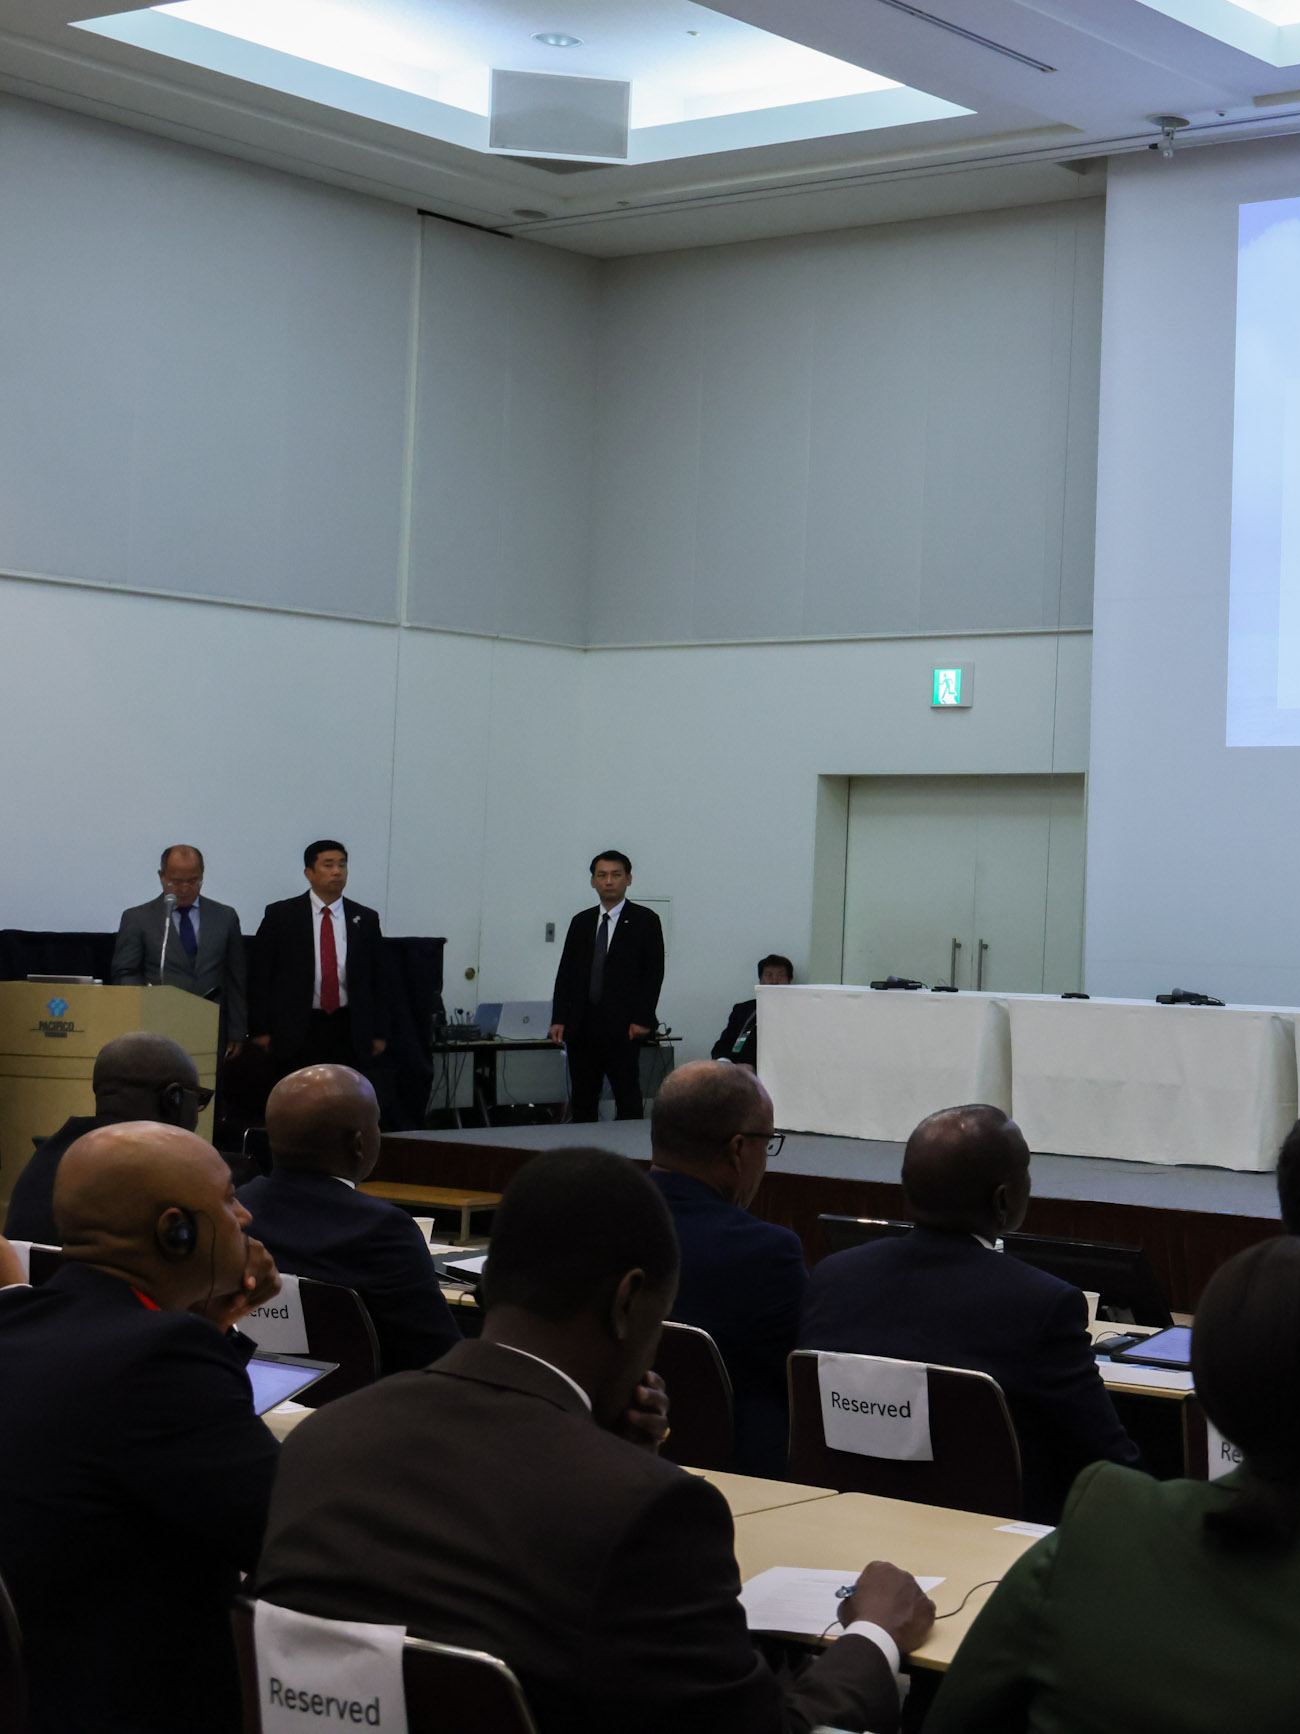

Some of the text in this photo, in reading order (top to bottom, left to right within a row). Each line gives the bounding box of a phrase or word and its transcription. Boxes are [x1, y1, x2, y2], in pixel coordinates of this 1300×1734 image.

[246, 1304, 290, 1320] erved
[831, 1391, 912, 1419] Reserved
[269, 1676, 381, 1727] Reserved
